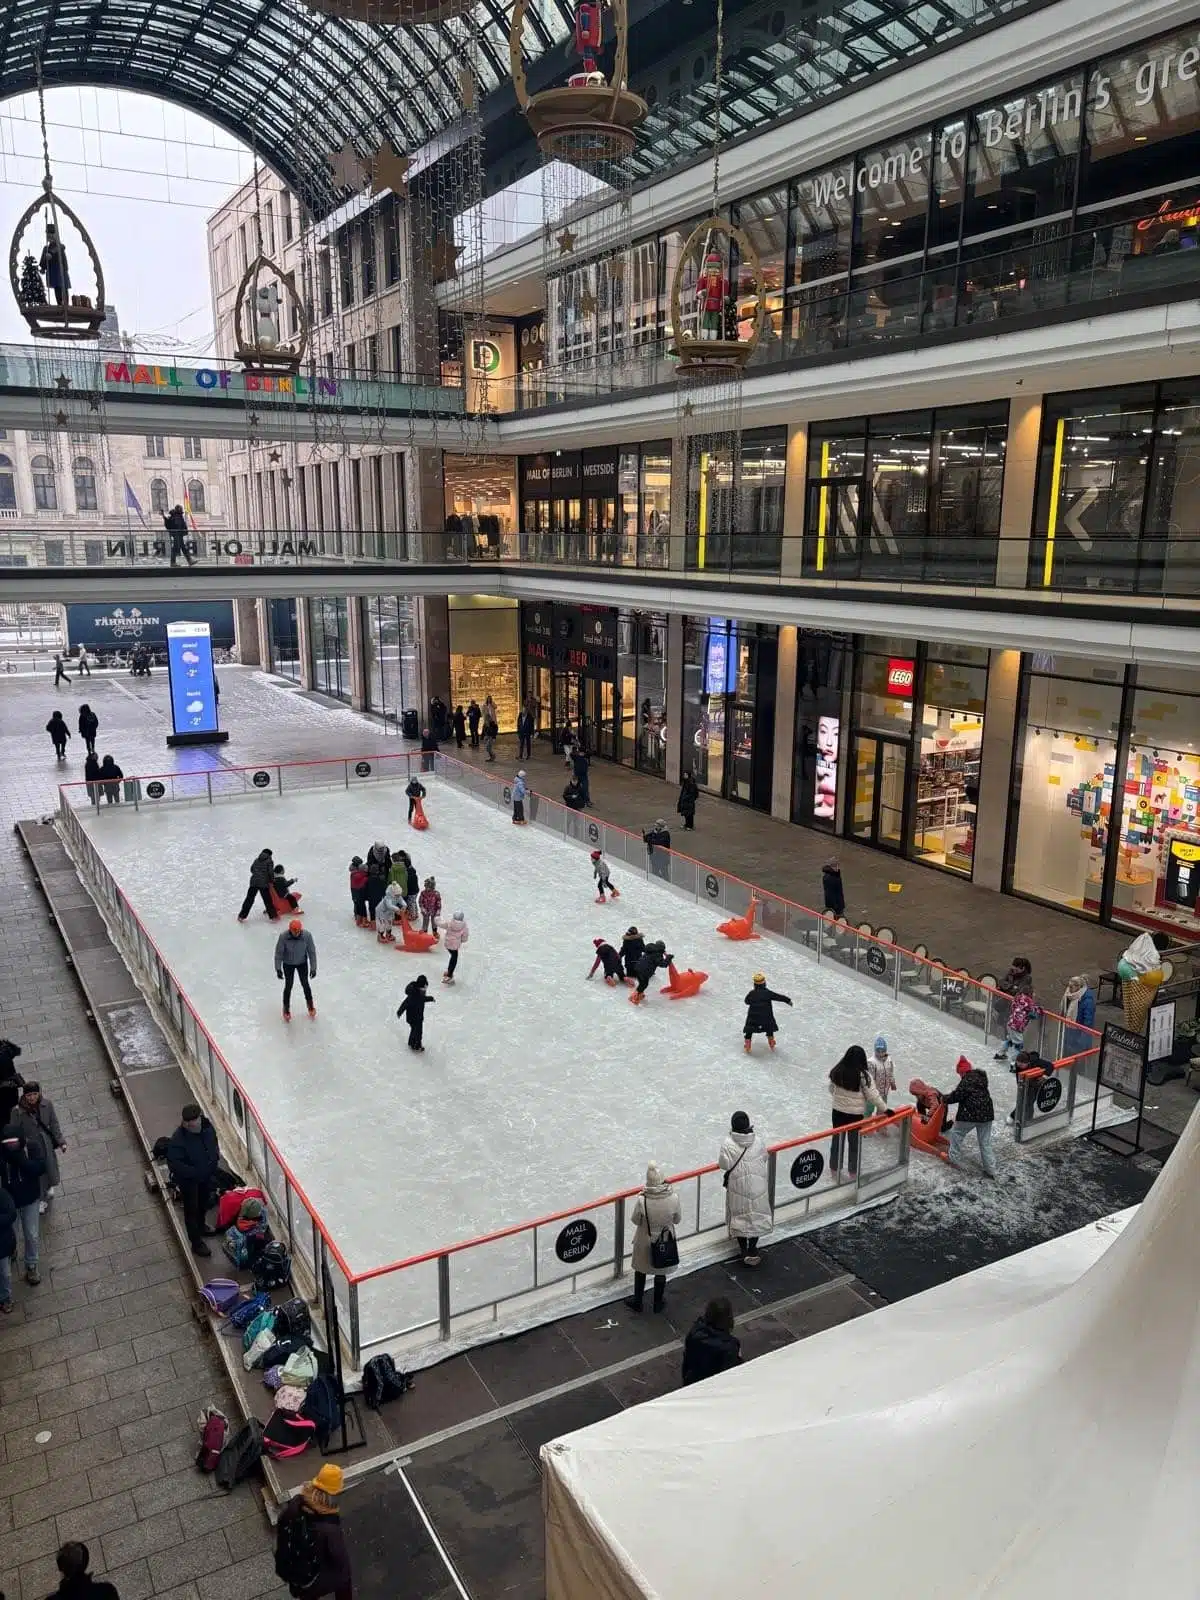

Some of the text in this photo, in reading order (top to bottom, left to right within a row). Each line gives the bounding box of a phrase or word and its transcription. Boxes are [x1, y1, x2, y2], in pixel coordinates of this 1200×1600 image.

[812, 144, 923, 208] Welcome
[938, 131, 966, 164] to
[986, 70, 1111, 147] Berlin's
[105, 362, 338, 396] MALL OF BERLIN
[526, 463, 615, 480] MALL OF BERLIN WESTSIDE
[888, 667, 913, 686] LEGO
[800, 1152, 816, 1165] MALL
[803, 1163, 812, 1173] OF
[796, 1171, 818, 1185] BERLIN
[565, 1223, 588, 1238] MALL
[571, 1234, 583, 1246] OF
[563, 1243, 590, 1260] BERLIN
